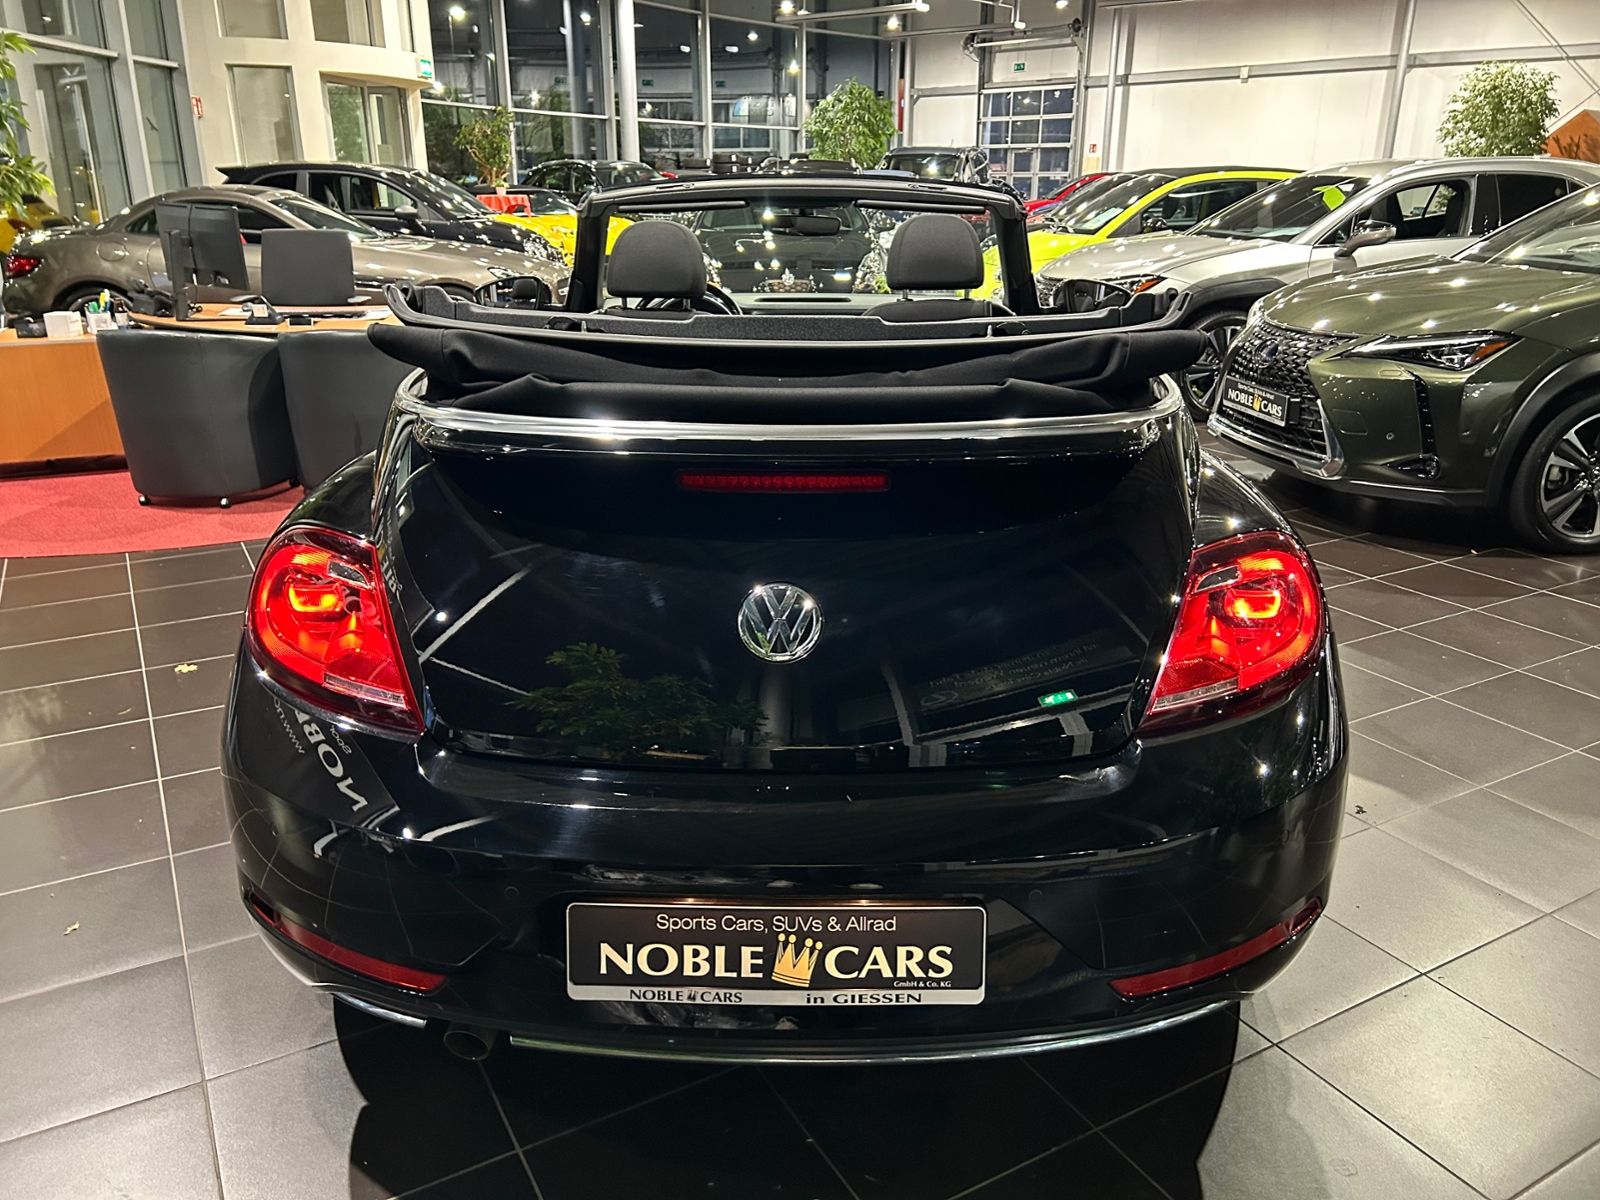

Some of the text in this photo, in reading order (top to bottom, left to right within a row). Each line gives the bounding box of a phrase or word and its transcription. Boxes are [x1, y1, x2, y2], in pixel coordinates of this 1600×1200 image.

[1228, 388, 1254, 407] NOBLE
[1261, 400, 1282, 416] CARS
[656, 913, 897, 934] Sports Cars, SUVs & Allrad
[599, 942, 953, 979] NOBLE CARS
[629, 989, 742, 1003] NOBLE CARS
[806, 993, 922, 1004] in GIESSEN
